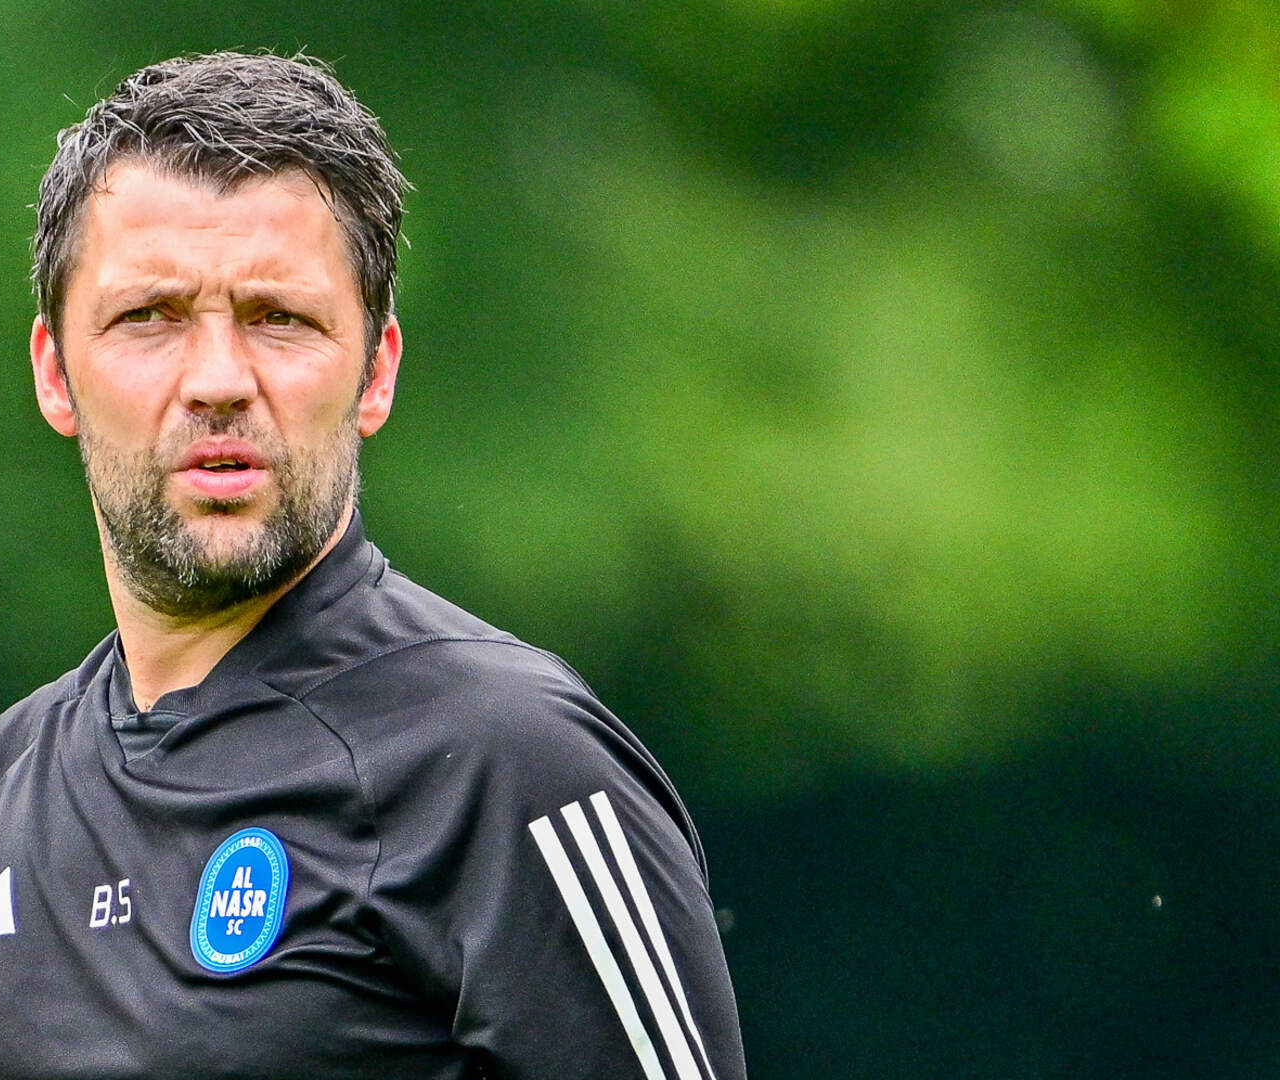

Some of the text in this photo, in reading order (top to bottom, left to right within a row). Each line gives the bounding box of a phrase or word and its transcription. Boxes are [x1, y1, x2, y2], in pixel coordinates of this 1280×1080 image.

[232, 866, 253, 889] AL
[89, 878, 132, 928] B.S
[210, 889, 267, 918] NASR
[226, 919, 244, 935] SC
